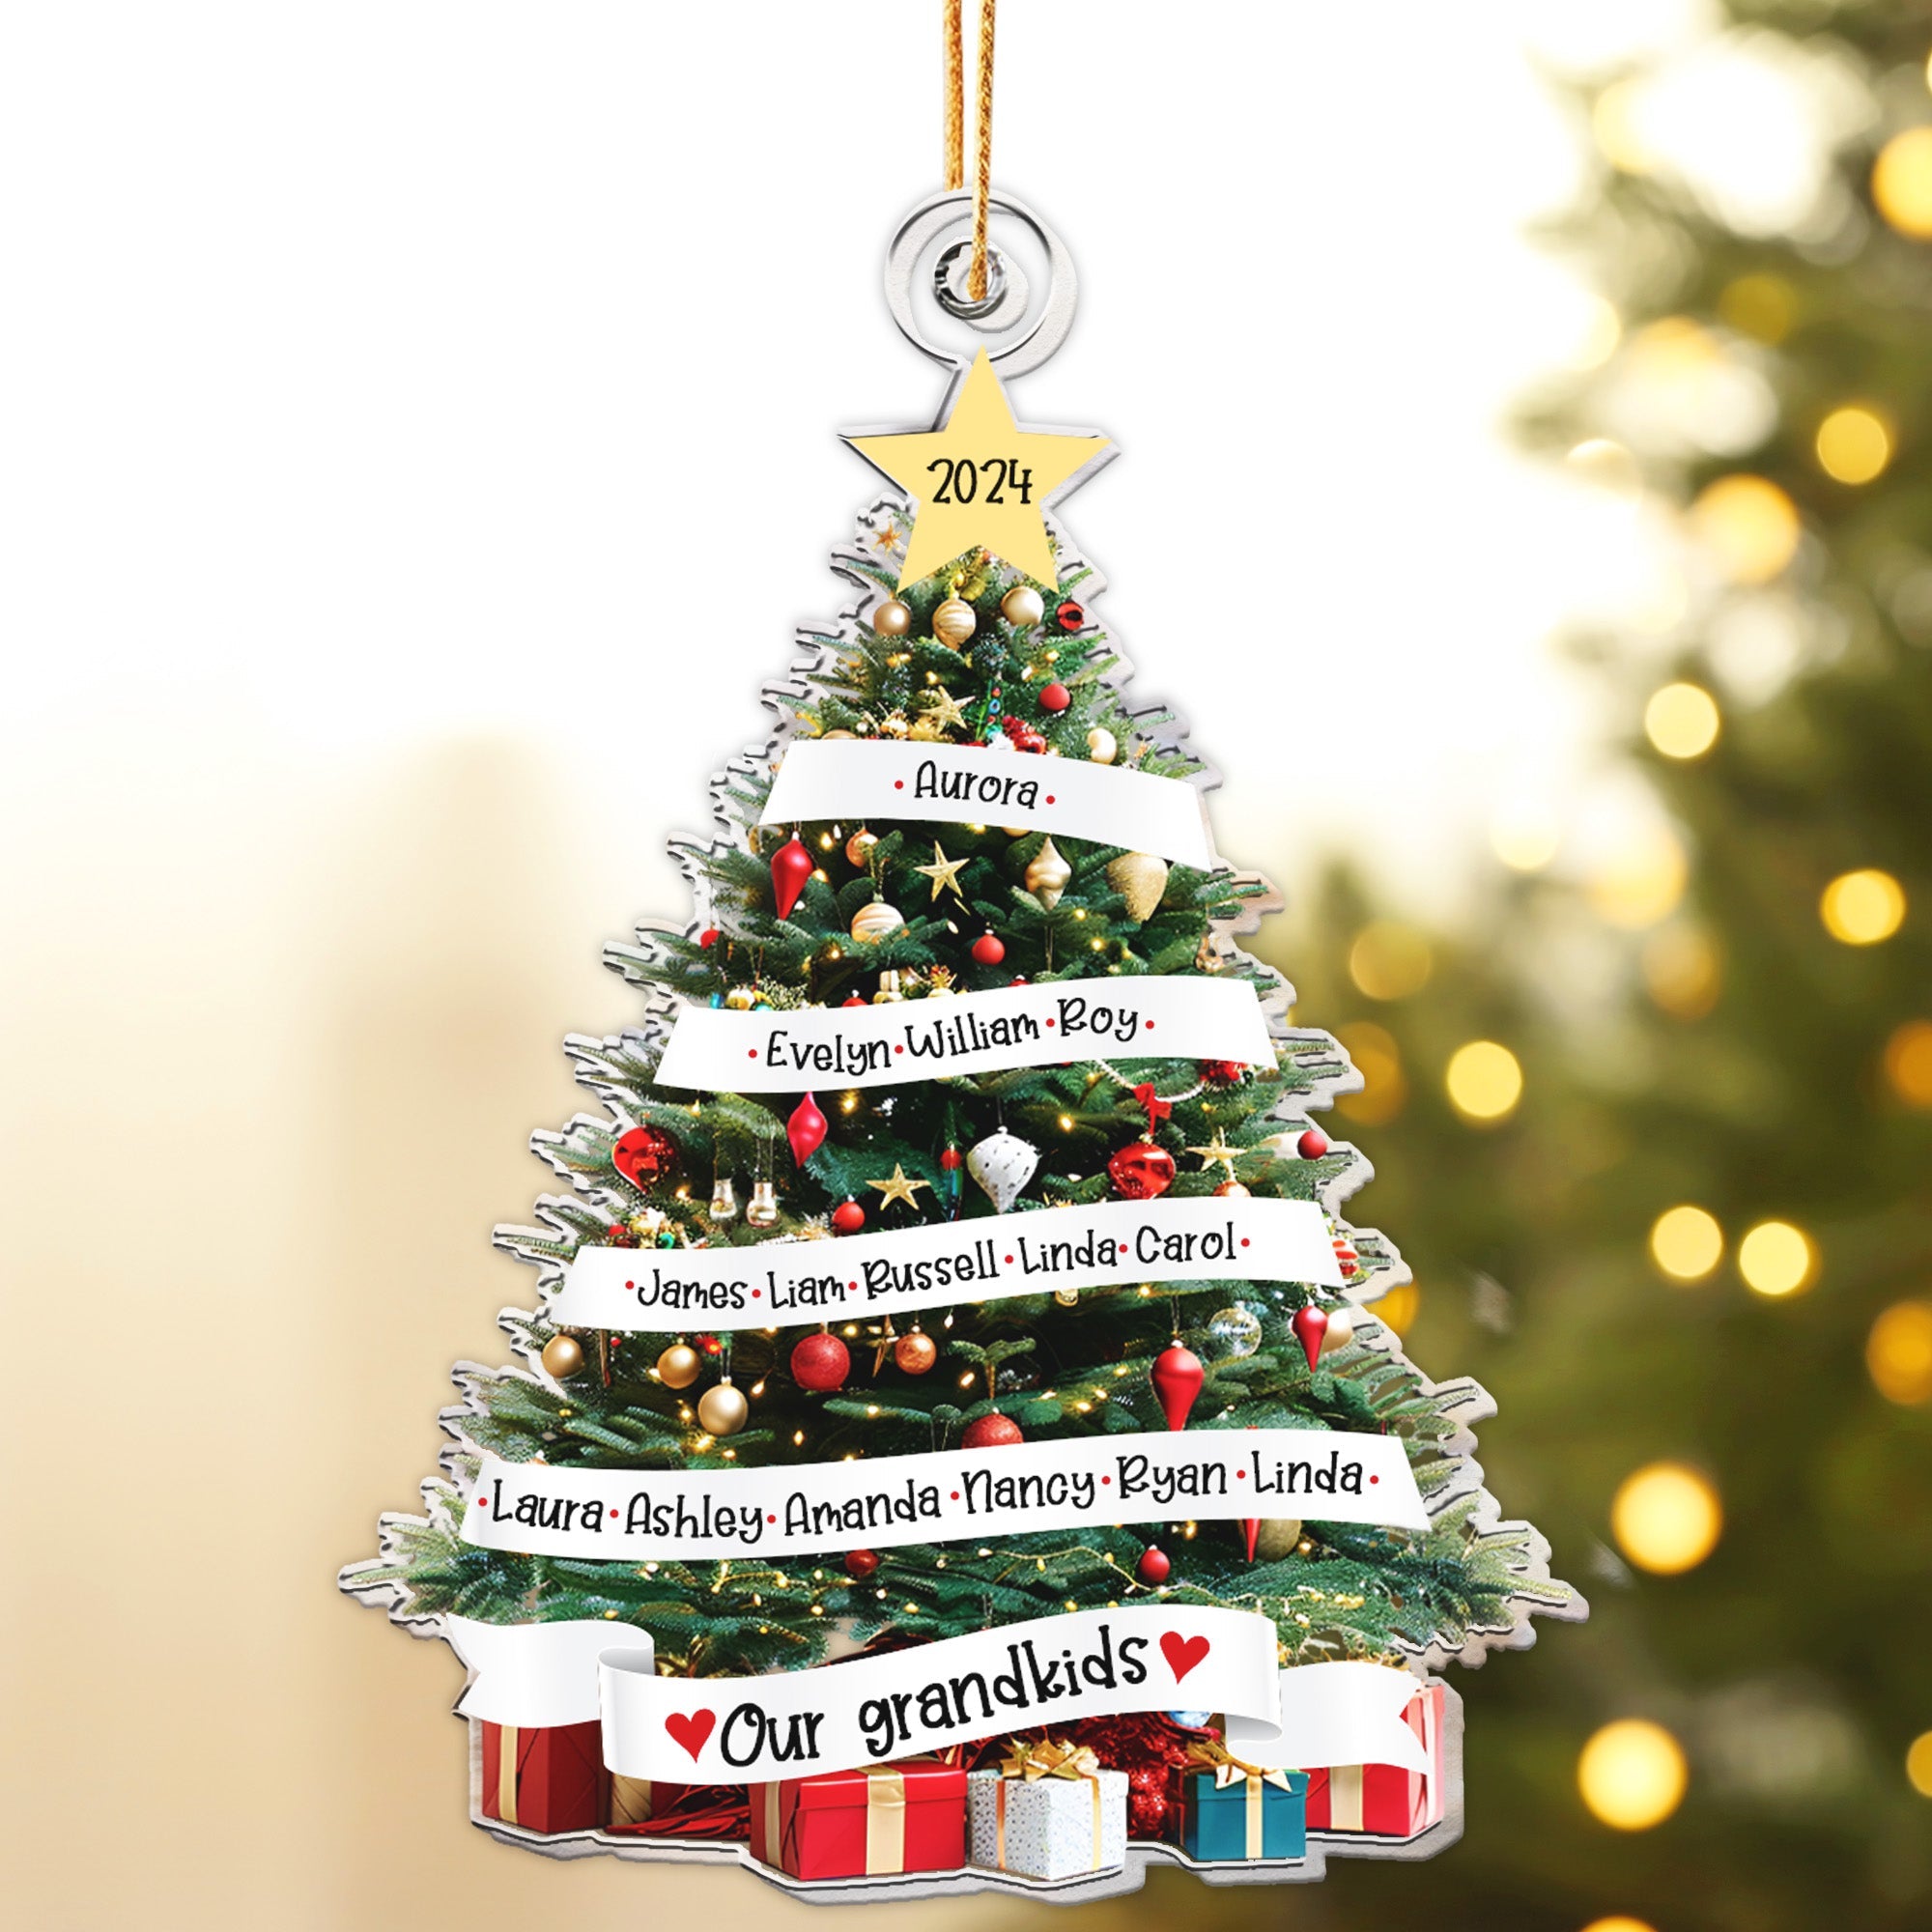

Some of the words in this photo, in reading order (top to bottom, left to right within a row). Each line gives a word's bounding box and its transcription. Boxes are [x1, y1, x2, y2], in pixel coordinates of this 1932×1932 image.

[926, 458, 1033, 504] 2024
[914, 759, 1038, 810] Aurora
[766, 1030, 892, 1076] Evelyn
[904, 1012, 1040, 1059] William
[1057, 997, 1139, 1042] Roy
[638, 1268, 749, 1310] James
[766, 1270, 846, 1309] Liam
[860, 1238, 1001, 1300] Russell
[1017, 1229, 1118, 1275] Linda
[1136, 1221, 1236, 1264] Carol
[492, 1478, 604, 1533] Laura
[624, 1492, 763, 1545] Ashley
[784, 1478, 942, 1537] Amanda
[961, 1469, 1095, 1515] Nancy
[1116, 1455, 1228, 1504] Ryan
[1251, 1450, 1363, 1495] Linda
[720, 1702, 825, 1768] Our
[858, 1624, 1150, 1757] grandkids
